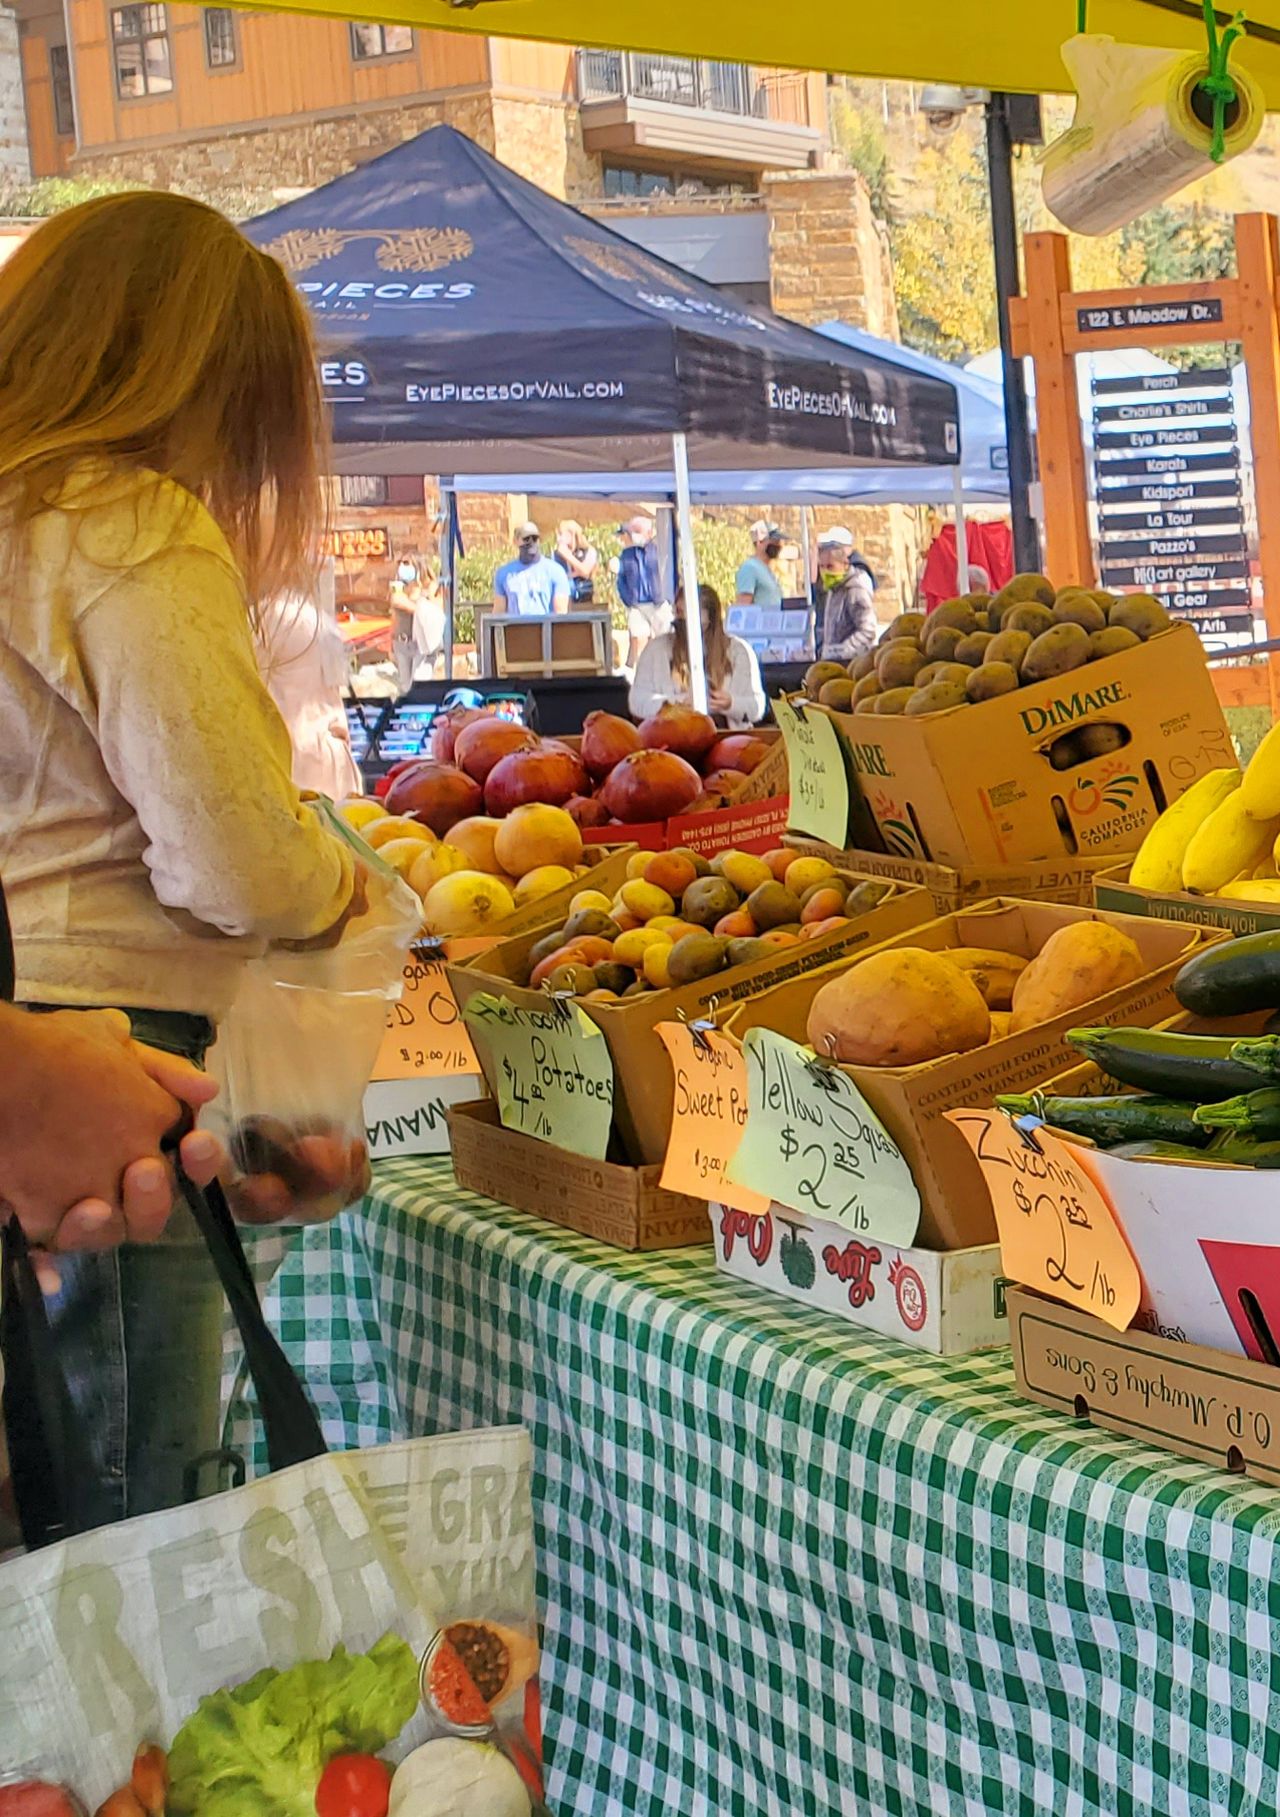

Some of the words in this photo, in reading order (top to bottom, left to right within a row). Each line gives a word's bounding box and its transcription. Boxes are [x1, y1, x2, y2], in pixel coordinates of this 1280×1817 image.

[1087, 311, 1109, 327] 122
[1128, 307, 1188, 324] Meadow
[1191, 304, 1212, 319] Dr.
[1143, 375, 1178, 389] Perch
[1118, 405, 1172, 419] Charlie's
[1174, 401, 1208, 415] Shirts
[1130, 433, 1154, 448] Eye
[1157, 429, 1199, 444] Pieces
[1146, 457, 1187, 472] Karats
[1142, 484, 1194, 500] Kidsport
[1147, 514, 1162, 527] La
[1167, 513, 1193, 526] Tour
[1150, 538, 1196, 554] Pazzo's
[1176, 564, 1216, 582] gallery
[1174, 592, 1207, 607] Gear
[1202, 617, 1227, 633] Arts
[1080, 808, 1149, 839] CALIFORNIA
[1087, 817, 1146, 848] TOMATOES
[531, 1036, 613, 1104] Potatoes
[748, 1040, 823, 1127] Yellow
[918, 1077, 972, 1108] COATED
[973, 1057, 1012, 1083] WITH
[956, 1092, 979, 1108] TO
[982, 1063, 1048, 1100] MAINTAIN
[677, 1069, 724, 1119] Sweet
[1045, 1347, 1097, 1393] Sons
[1124, 1364, 1217, 1429] Murphy
